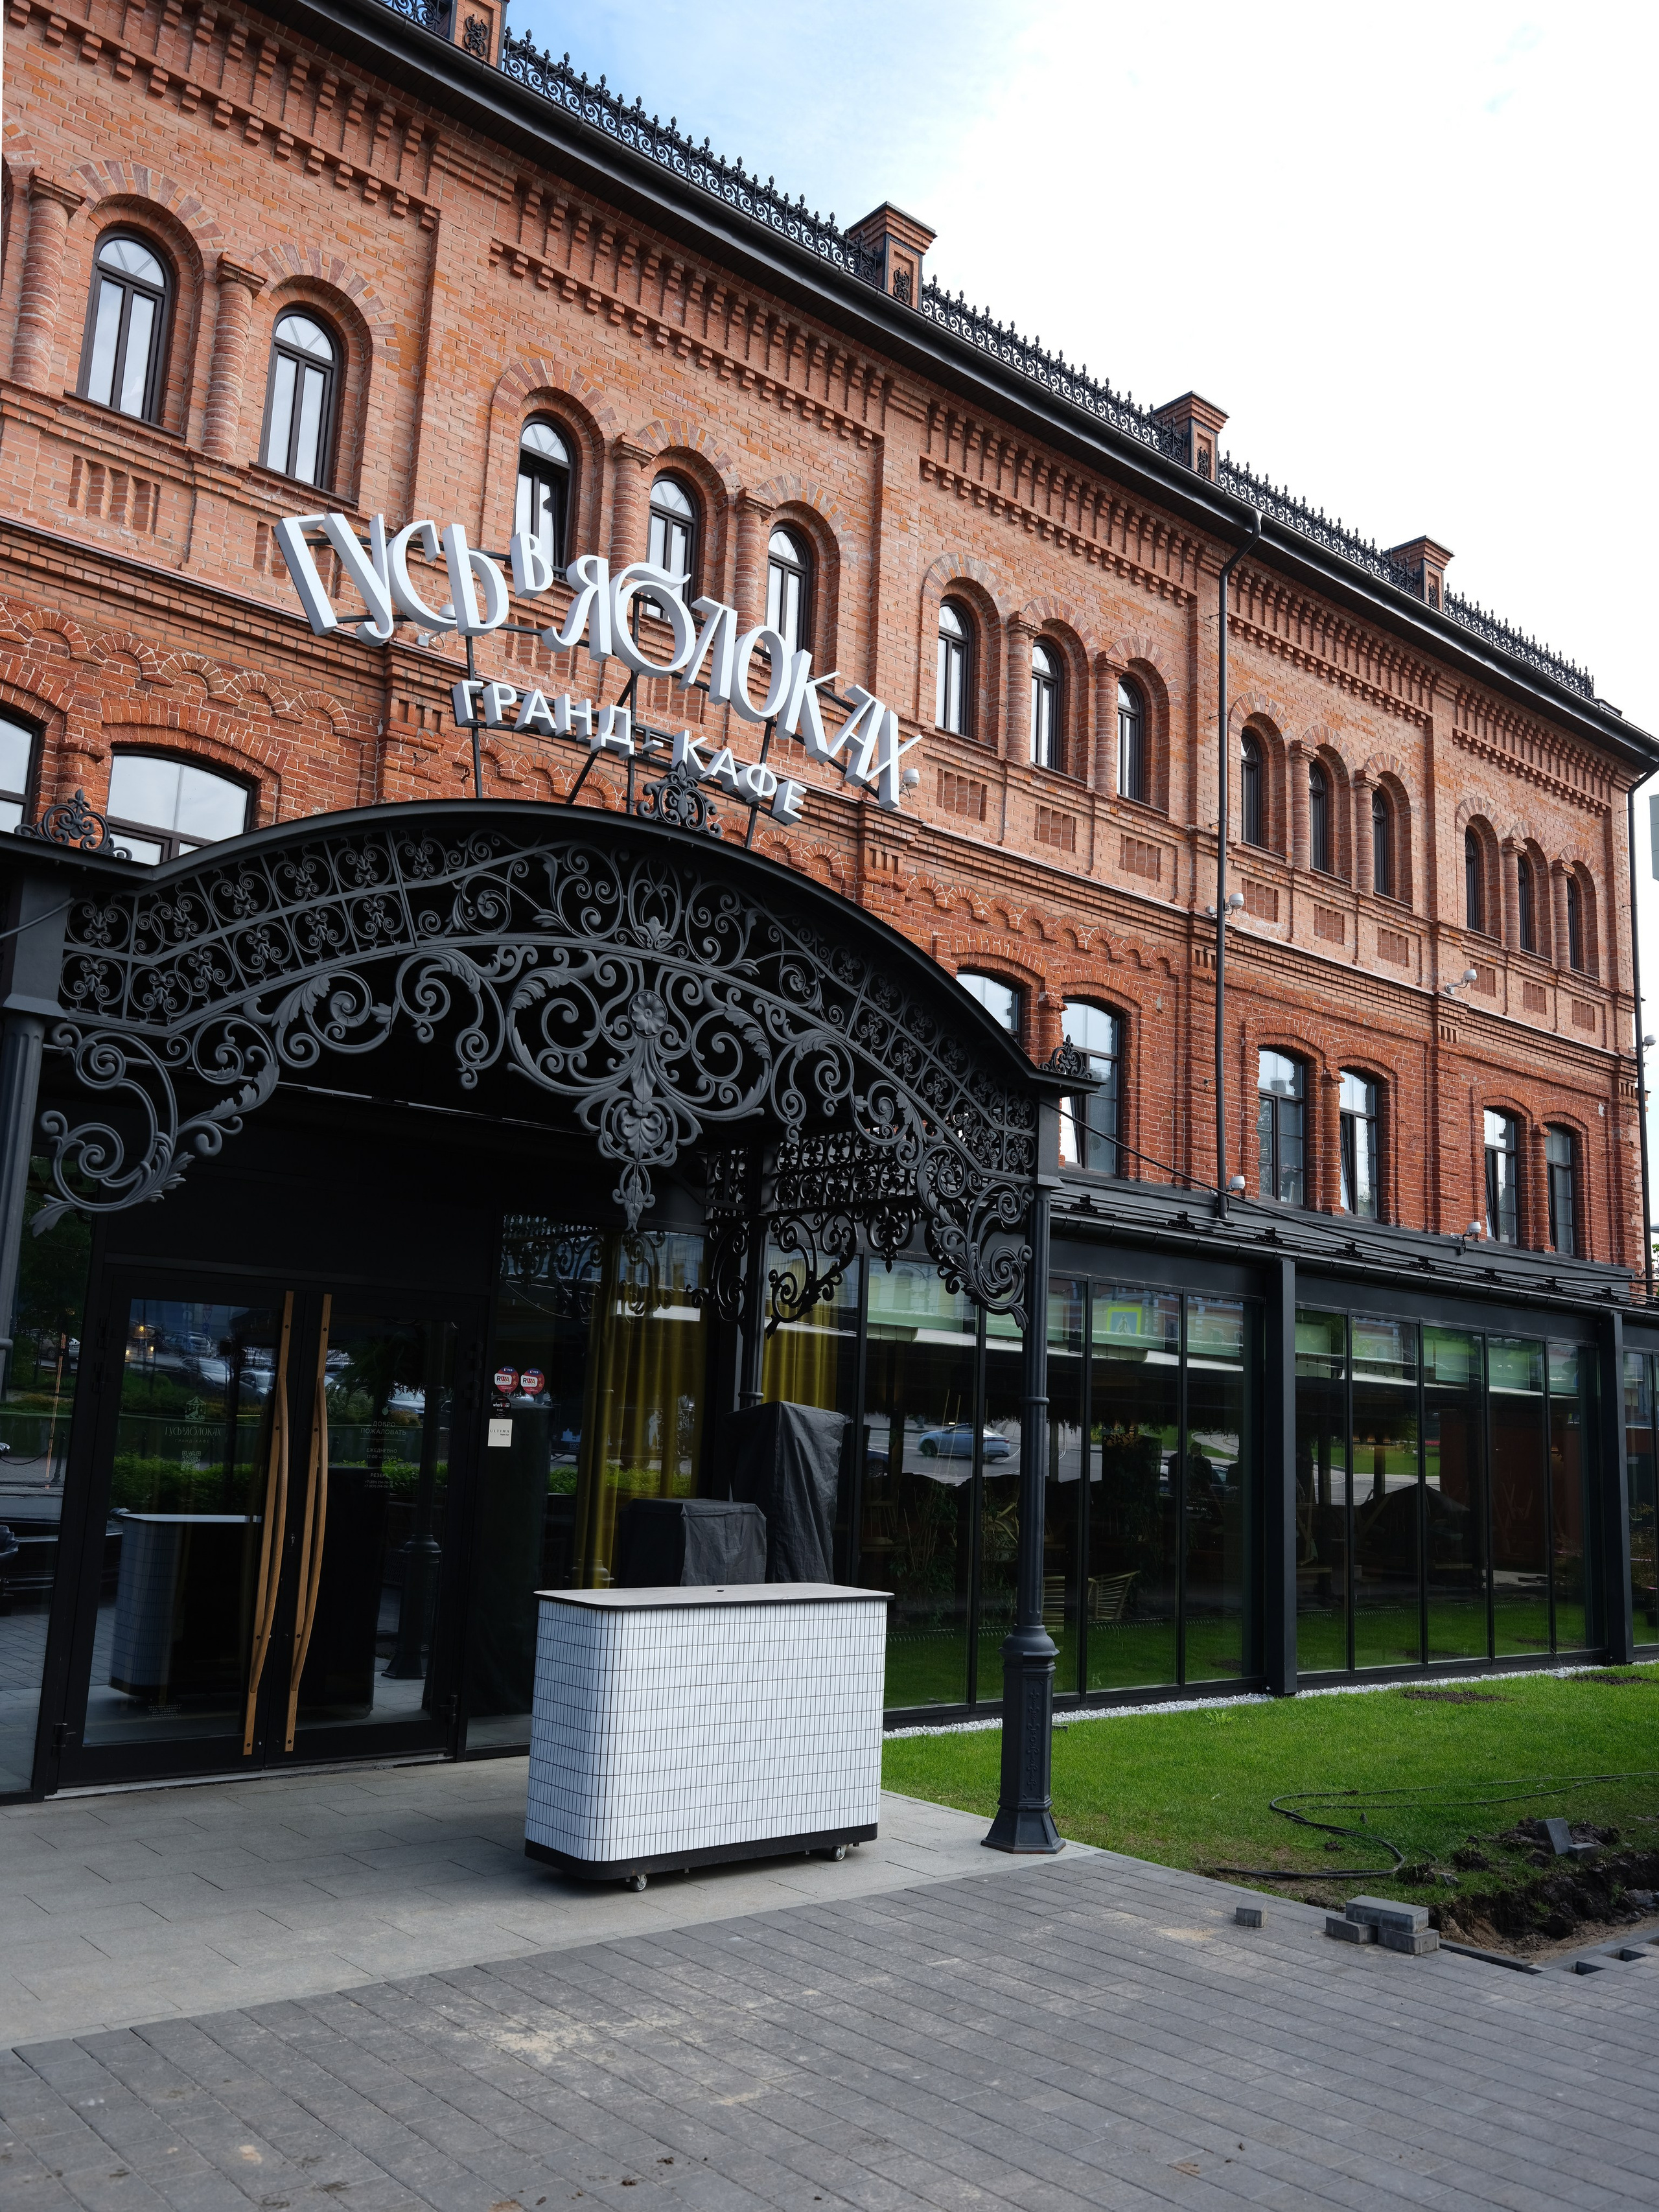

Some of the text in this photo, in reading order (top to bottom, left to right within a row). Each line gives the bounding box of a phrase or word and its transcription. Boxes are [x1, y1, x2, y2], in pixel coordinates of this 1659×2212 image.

[274, 513, 509, 646] ГУСЬ
[542, 554, 923, 811] ЯБЛОКАХ
[450, 679, 807, 825] ГРАНД-КАФЕ
[165, 1426, 182, 1437] ГУСЬ
[184, 1426, 222, 1437] ЯБЛОКАХ
